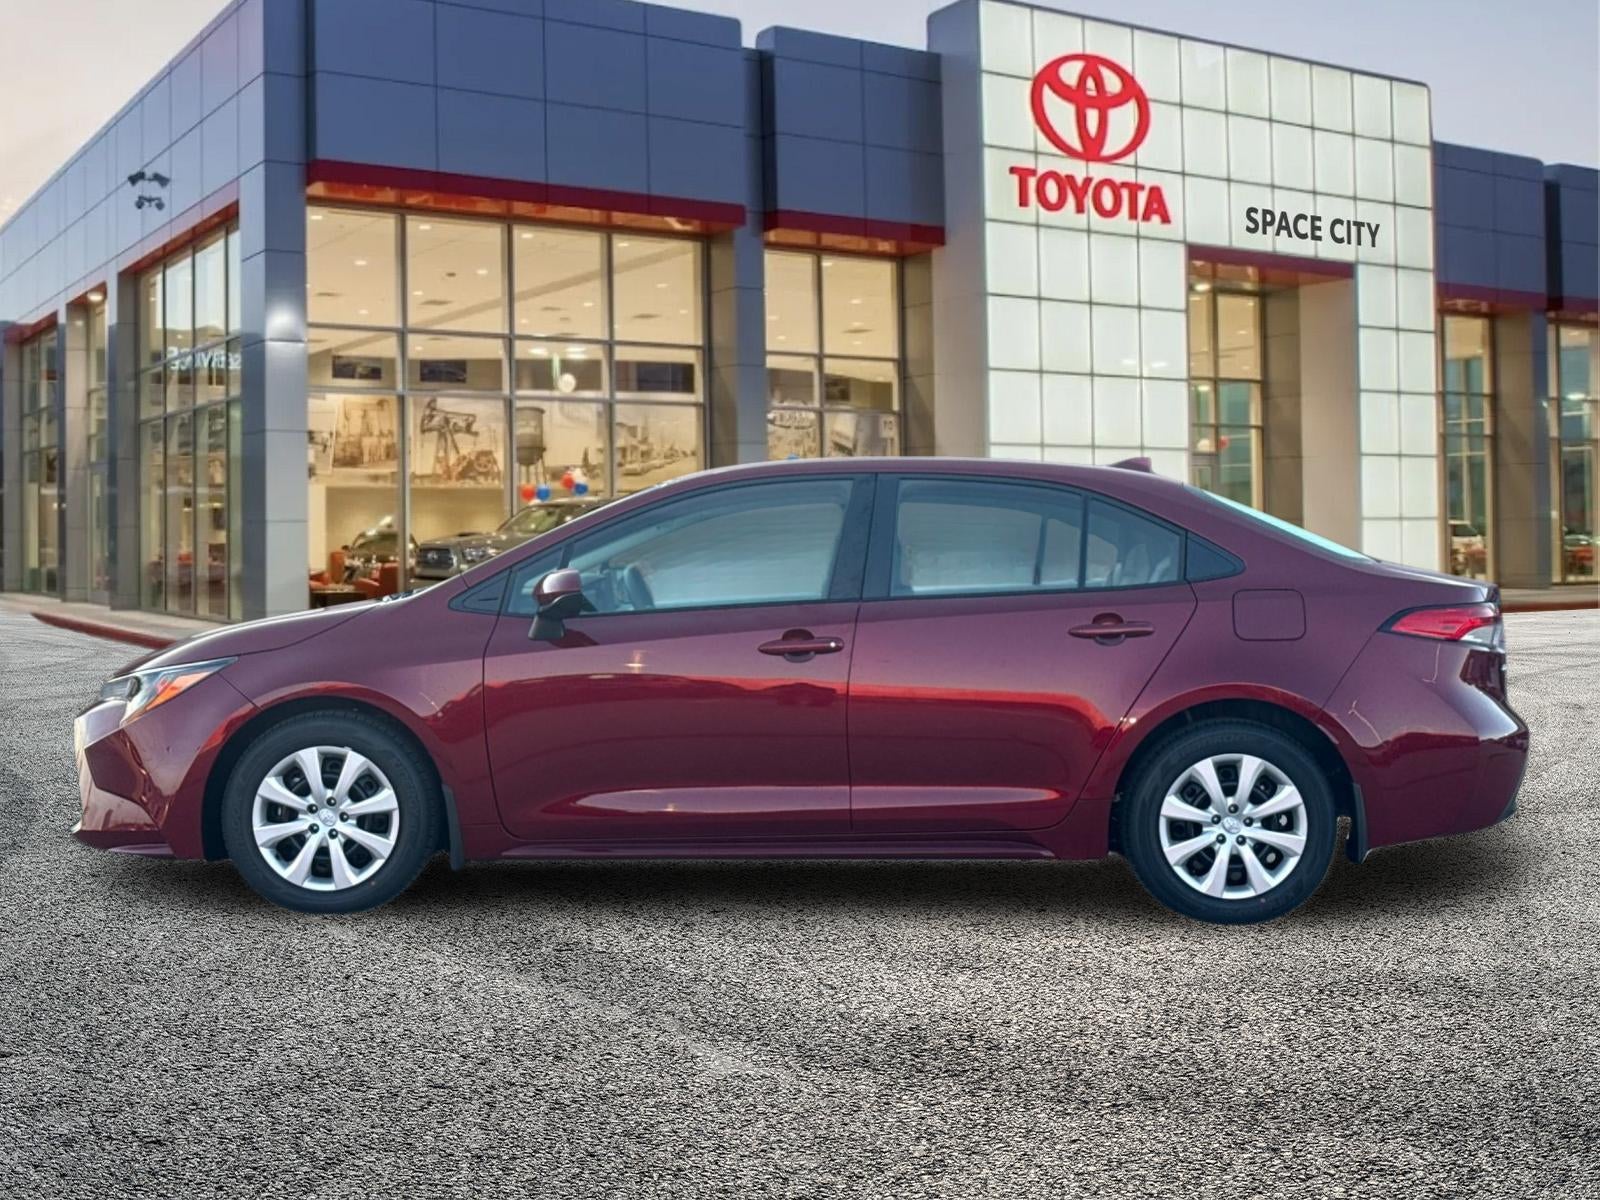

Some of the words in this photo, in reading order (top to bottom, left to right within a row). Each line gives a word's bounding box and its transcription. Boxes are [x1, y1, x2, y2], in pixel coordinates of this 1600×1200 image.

[1009, 166, 1171, 224] TOYOTA
[1245, 206, 1323, 242] SPACE
[1329, 217, 1381, 248] CITY
